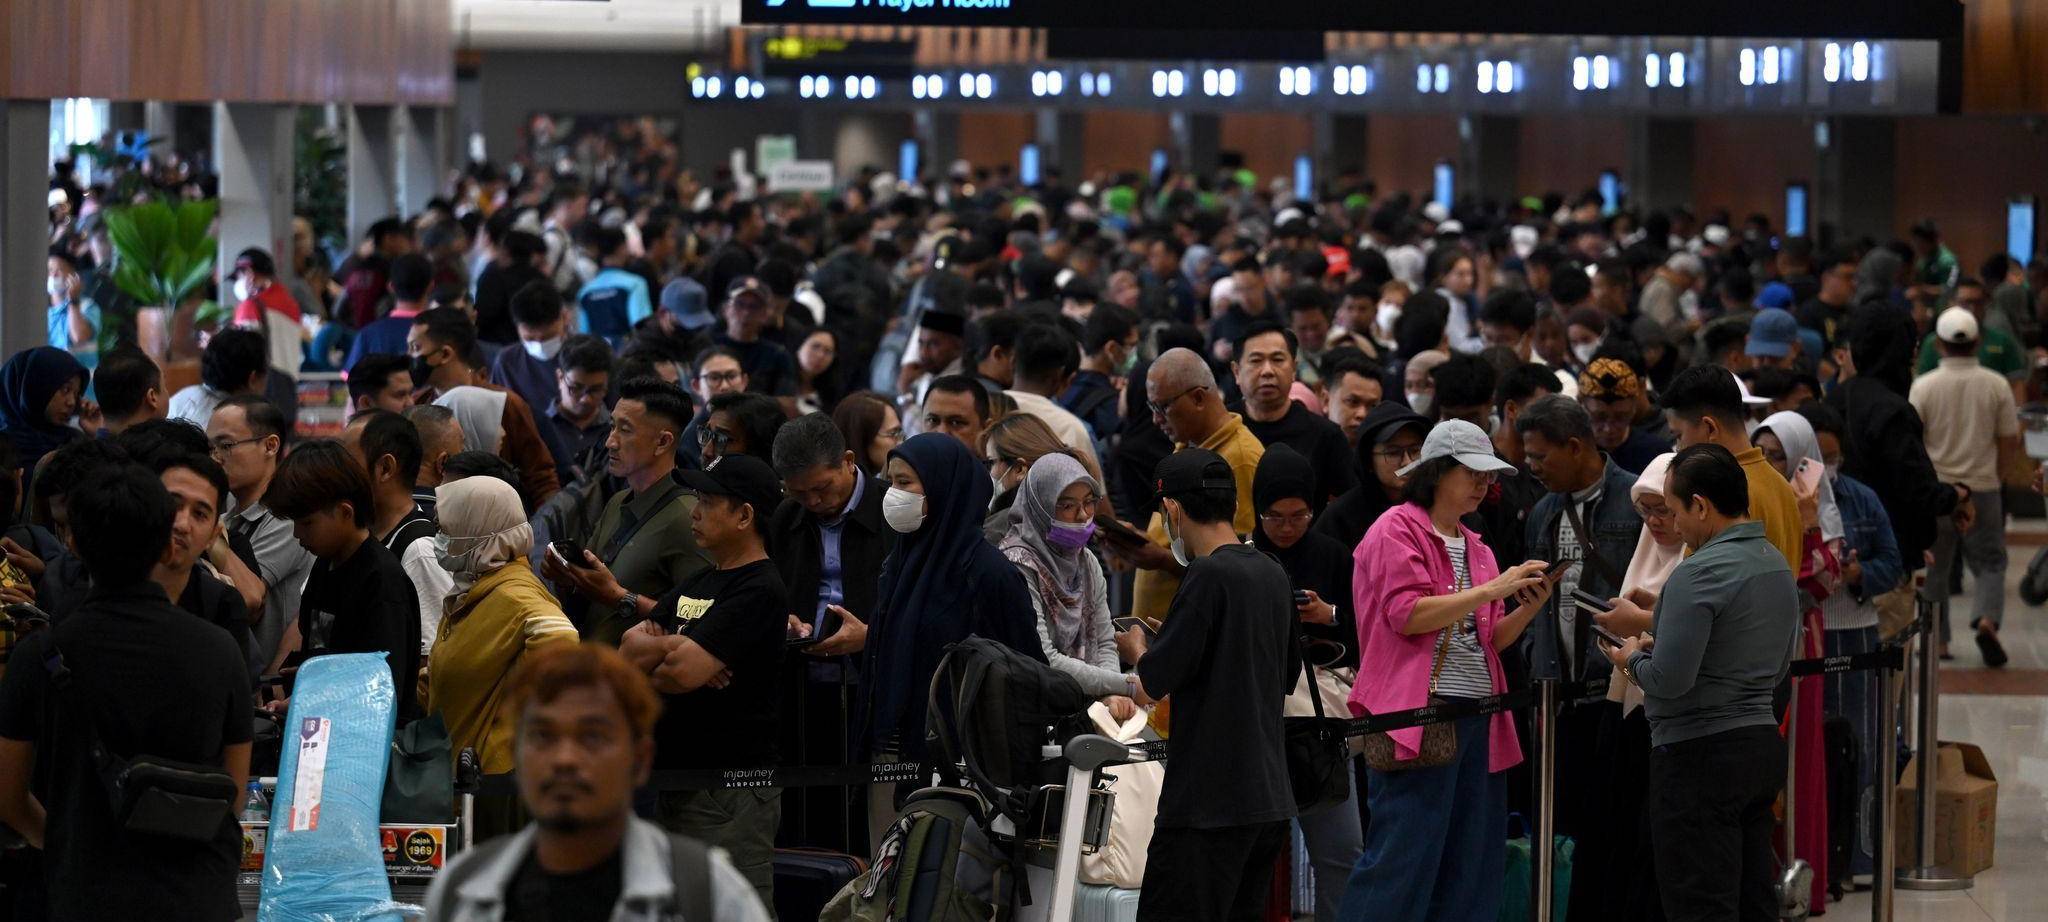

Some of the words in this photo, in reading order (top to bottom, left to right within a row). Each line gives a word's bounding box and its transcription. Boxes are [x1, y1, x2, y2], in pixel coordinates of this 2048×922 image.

[871, 762, 920, 775] injourney
[723, 768, 774, 781] injourney
[873, 774, 919, 782] AIRPORTS
[726, 780, 772, 788] AIRPORTS
[411, 837, 431, 846] Sejak
[409, 845, 432, 855] 1969
